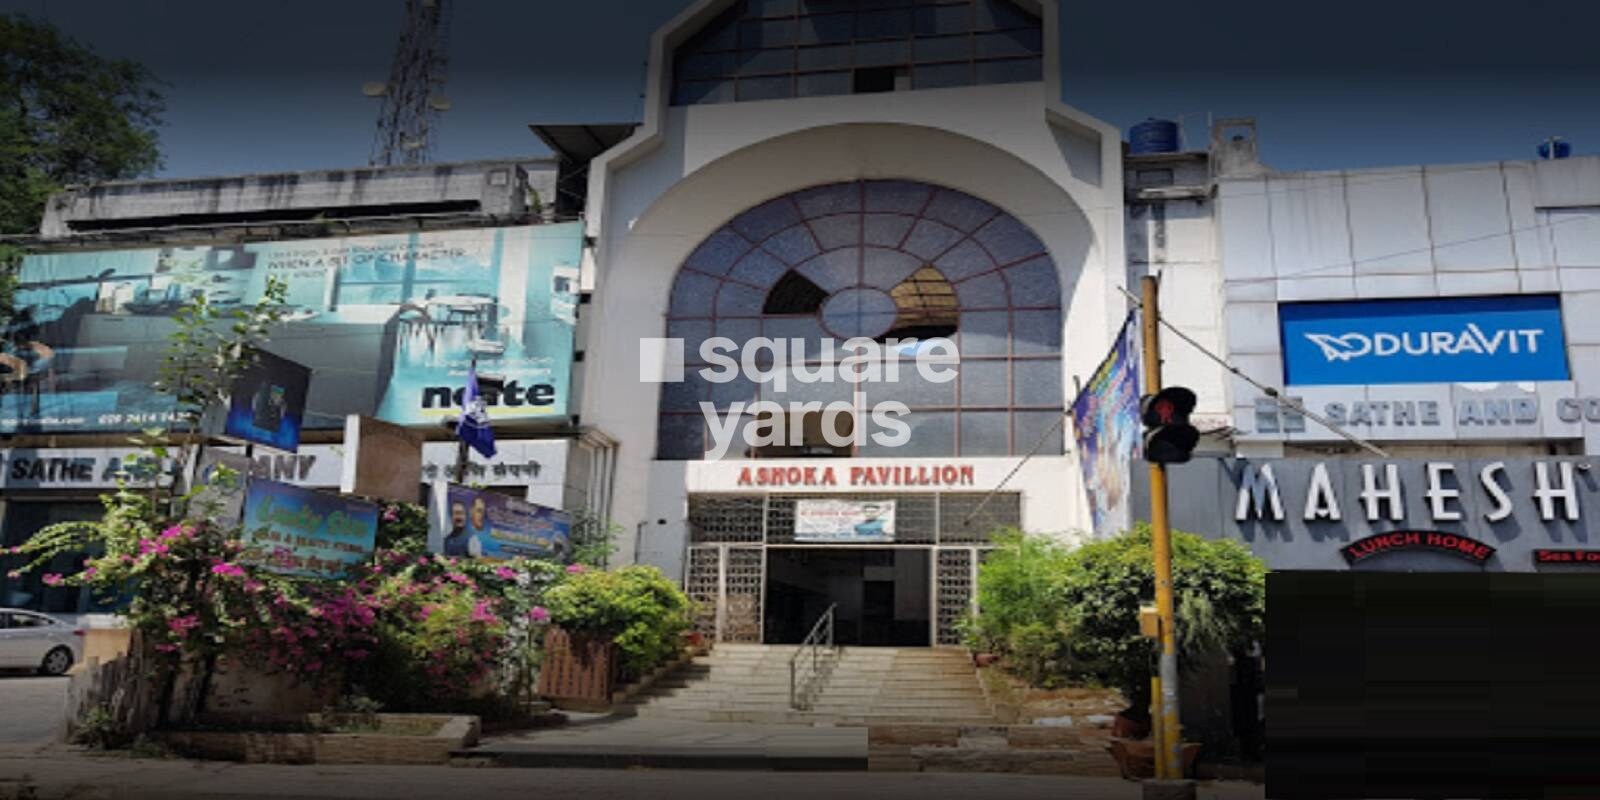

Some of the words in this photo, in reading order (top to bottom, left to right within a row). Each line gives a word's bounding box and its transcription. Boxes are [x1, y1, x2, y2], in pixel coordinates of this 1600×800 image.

[1375, 323, 1544, 357] DURAVIT
[1324, 399, 1441, 428] SATHE
[1459, 397, 1539, 426] AND
[11, 457, 97, 483] SATHE
[737, 466, 837, 487] ASHOKA
[849, 465, 975, 487] PAVILLION
[1235, 460, 1581, 522] MAHESH
[1349, 532, 1421, 559] LUNCH
[1427, 533, 1491, 560] HOME
